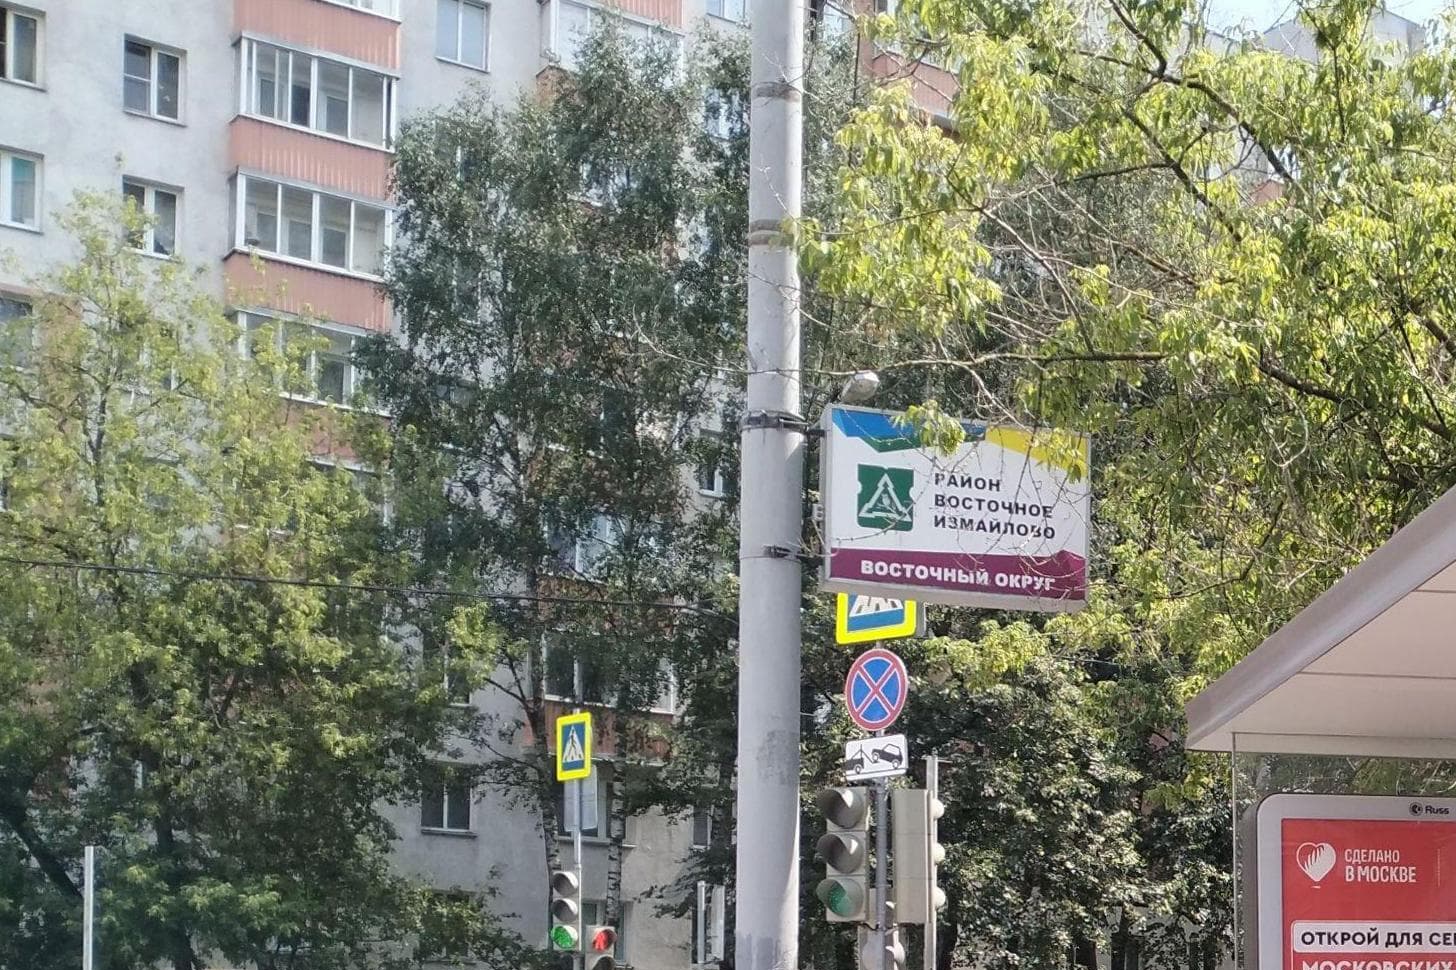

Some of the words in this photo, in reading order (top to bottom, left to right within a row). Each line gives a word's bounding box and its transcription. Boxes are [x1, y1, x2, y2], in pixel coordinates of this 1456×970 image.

[934, 472, 1001, 492] РАЙОН
[934, 494, 1053, 519] ВОСТОЧНОЕ
[934, 515, 1056, 539] ИЗМАЙЛОВО
[860, 560, 989, 586] ВОСТОЧНЫЙ
[995, 573, 1056, 591] ОКРУГ
[1425, 805, 1450, 814] Russ
[1345, 849, 1400, 864] СДЕЛАНО
[1345, 867, 1355, 882] В
[1357, 866, 1417, 883] МОСКВЕ
[1301, 928, 1380, 947] ОТКРОЙ
[1385, 932, 1423, 949] ДЛЯ
